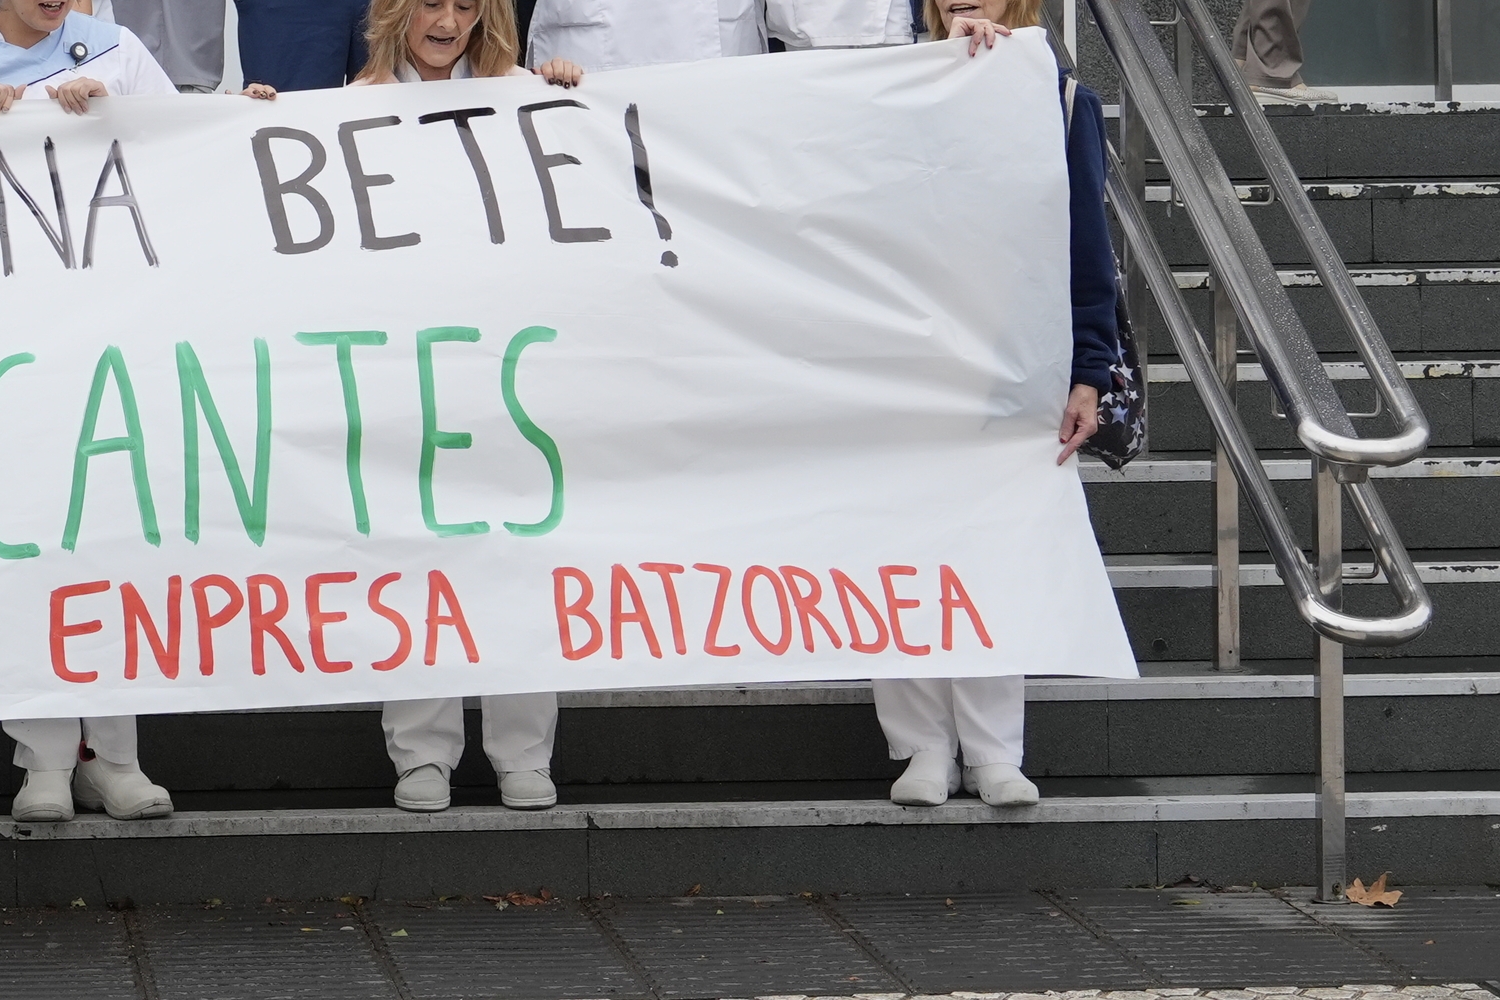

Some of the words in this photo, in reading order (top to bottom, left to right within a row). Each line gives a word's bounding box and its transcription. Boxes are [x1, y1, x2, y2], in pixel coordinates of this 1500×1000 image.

[249, 98, 680, 269] BETE!
[49, 568, 481, 684] ENPRESA
[551, 562, 995, 661] BATZORDEA
